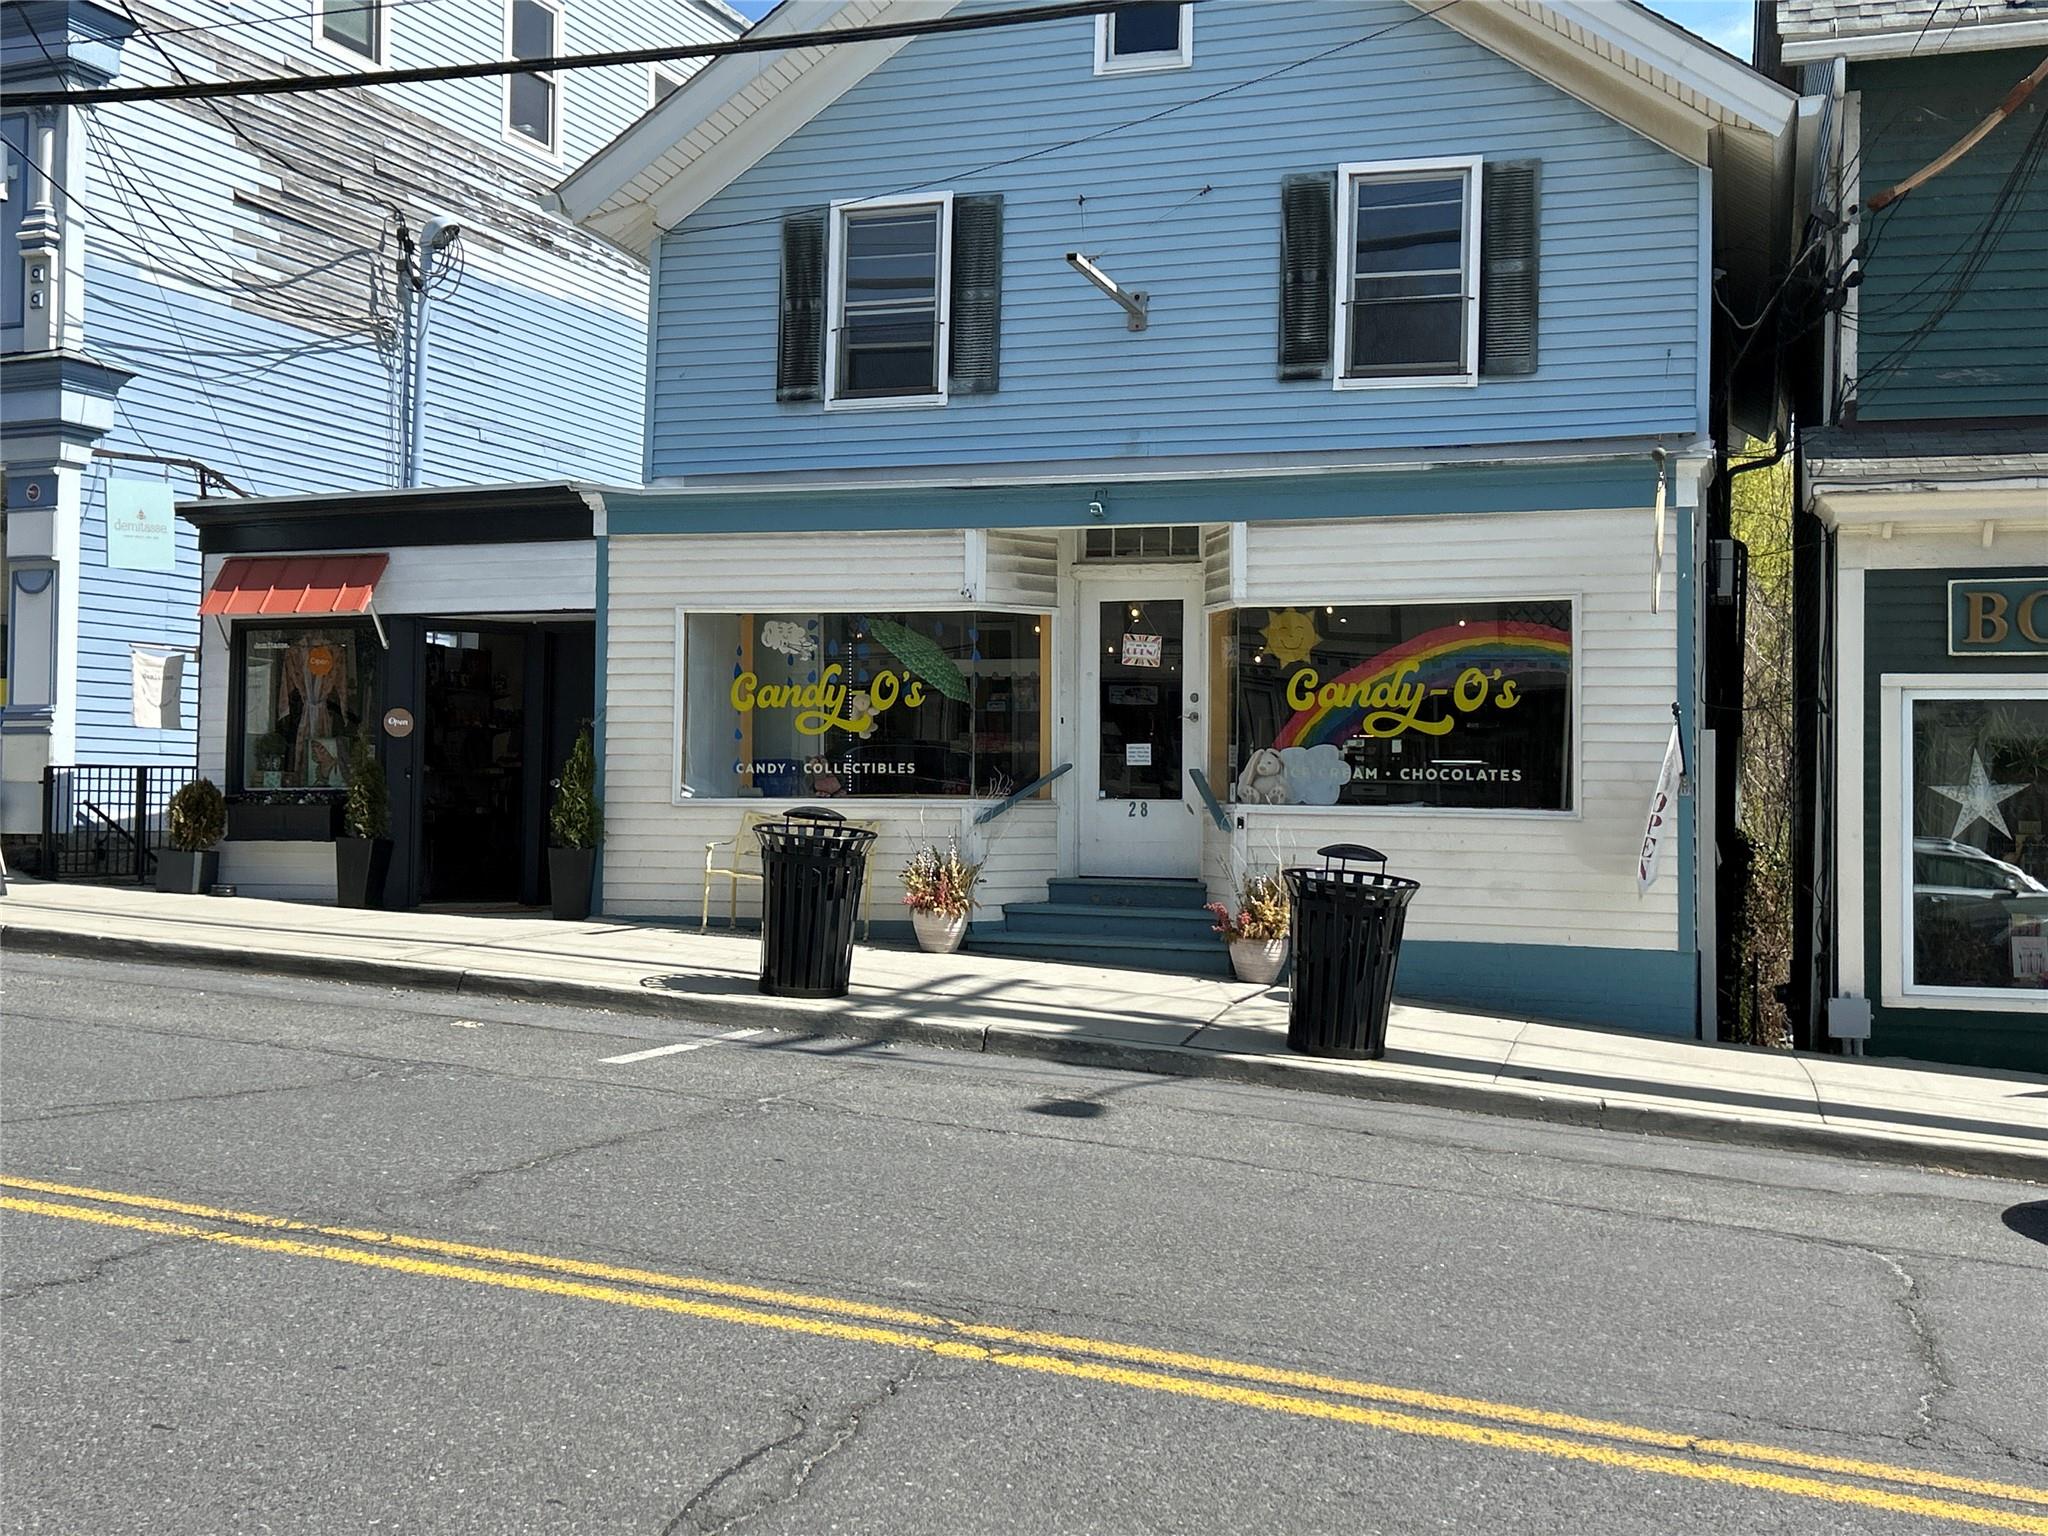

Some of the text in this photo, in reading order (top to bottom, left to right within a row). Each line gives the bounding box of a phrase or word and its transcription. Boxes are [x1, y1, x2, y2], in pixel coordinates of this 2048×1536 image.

[730, 663, 926, 736] Candy-O's
[1286, 661, 1521, 738] Candy-O's
[388, 717, 408, 727] Open
[735, 762, 916, 775] CANDY COLLECTIBLES
[1400, 768, 1522, 782] CHOCOLATES
[1128, 801, 1148, 818] 28
